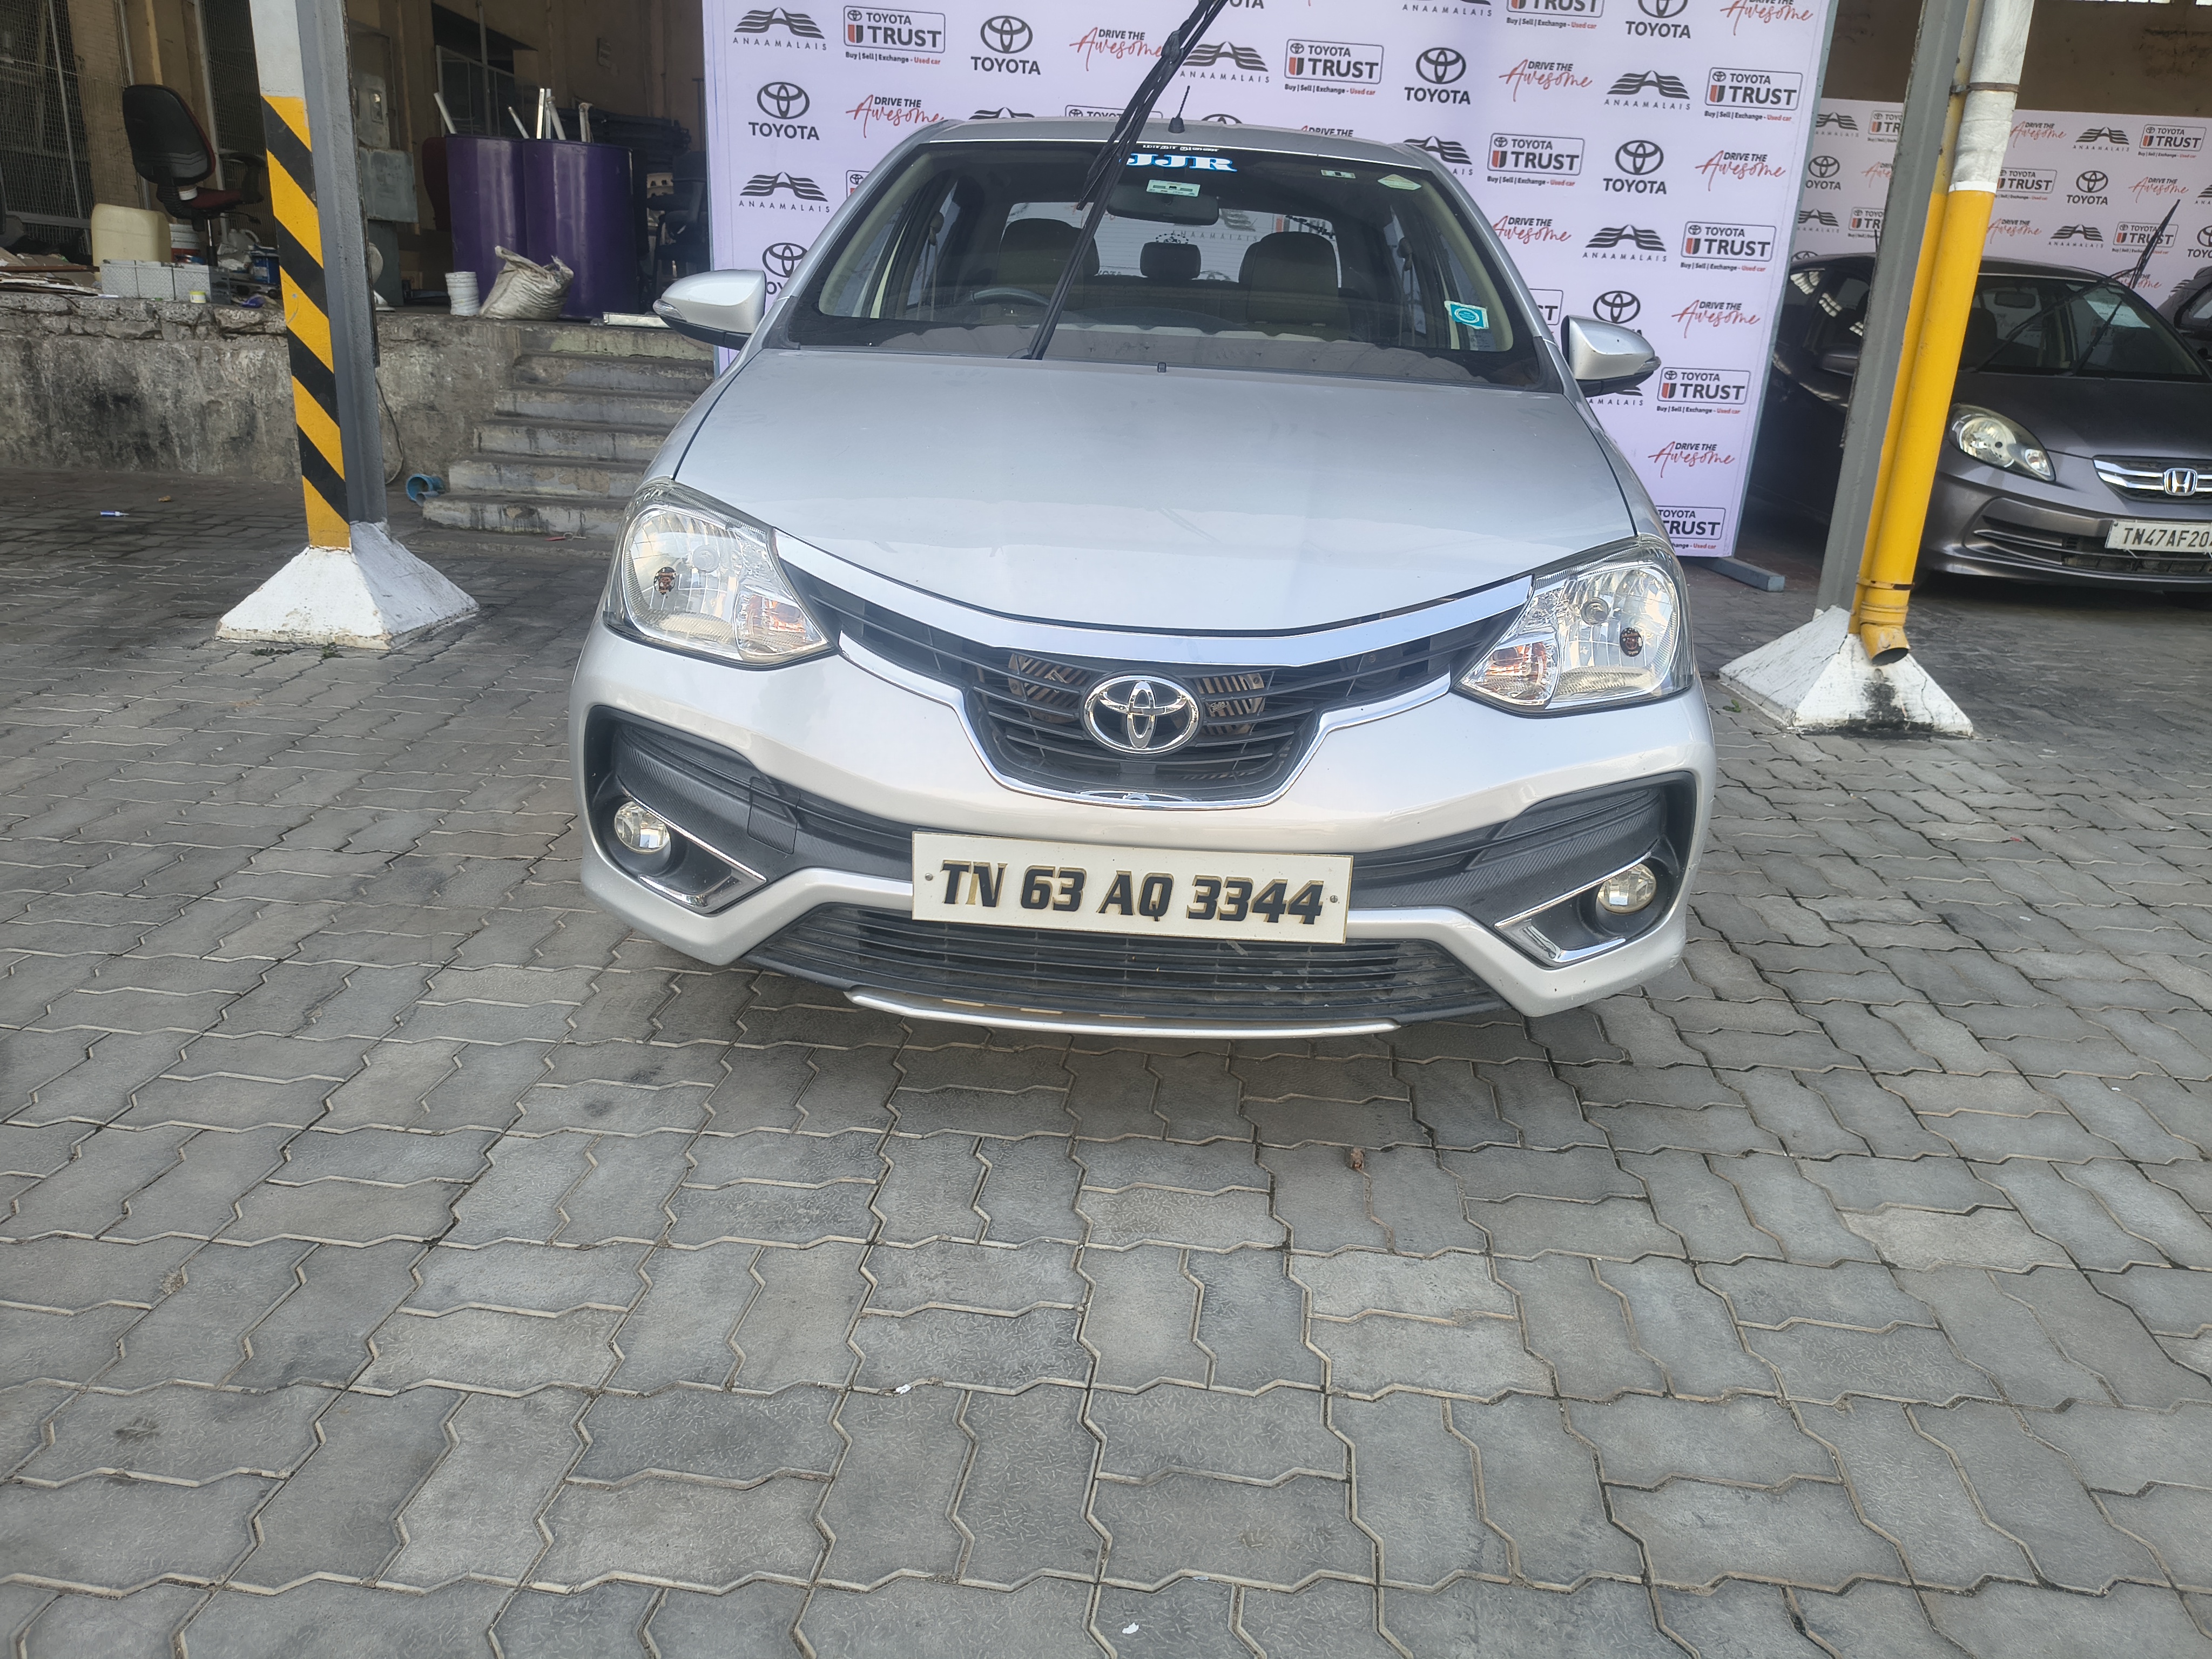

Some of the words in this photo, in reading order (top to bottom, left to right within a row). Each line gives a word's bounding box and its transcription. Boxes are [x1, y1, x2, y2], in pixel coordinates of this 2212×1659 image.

[1402, 4, 1492, 17] ANAAMALAIS
[866, 12, 912, 25] TOYOTA
[1507, 17, 1518, 25] Buy
[1538, 19, 1567, 28] Exchange
[1720, 0, 1813, 36] Awesome
[1098, 29, 1127, 40] DRIVE
[1128, 31, 1145, 41] THE
[1625, 21, 1691, 39] TOYOTA
[867, 26, 942, 48] TRUST
[732, 37, 827, 51] ANAAMALAIS
[1069, 27, 1163, 71] Awesome
[1308, 45, 1351, 57] TOYOTA
[845, 52, 858, 60] Buy
[879, 54, 909, 63] Exchange
[971, 56, 1041, 75] TOYOTA
[1308, 58, 1379, 79] TRUST
[1527, 61, 1555, 71] DRIVE
[1556, 63, 1573, 72] THE
[1179, 71, 1270, 83] ANAAMALAIS
[1499, 59, 1593, 102] Awesome
[1729, 73, 1771, 85] TOYOTA
[1284, 84, 1297, 92] Buy
[1316, 86, 1345, 95] Exchange
[1404, 87, 1471, 105] TOYOTA
[1729, 86, 1797, 106] TRUST
[874, 97, 902, 107] DRIVE
[904, 98, 922, 108] THE
[1604, 99, 1691, 111] ANAAMALAIS
[846, 94, 945, 138] Awesome
[1735, 112, 1763, 121] Exchange
[748, 122, 820, 140] TOYOTA
[1337, 129, 1354, 137] THE
[1511, 139, 1553, 150] TOYOTA
[2156, 136, 2202, 149] TRUST
[1510, 151, 1580, 171] TRUST
[1723, 152, 1750, 161] DRIVE
[1751, 154, 1768, 163] THE
[1695, 150, 1786, 192] Awesome
[1487, 176, 1499, 184] Buy
[1518, 178, 1546, 186] Exchange
[1603, 178, 1667, 195] TOYOTA
[1806, 180, 1841, 191] OYOTA
[2007, 179, 2052, 191] TRUST
[2066, 195, 2108, 205] TOYOTA
[739, 200, 831, 213] ANAAMALAIS
[1508, 217, 1534, 226] DRIVE
[1535, 218, 1553, 227] THE
[1705, 227, 1745, 238] TOYOTA
[1704, 238, 1770, 257] TRUST
[1582, 252, 1667, 262] ANAAMALAIS
[1699, 301, 1725, 310] DRIVE
[1725, 302, 1742, 311] THE
[1671, 300, 1761, 339] Awesome
[1681, 372, 1721, 382] TOYOTA
[1680, 383, 1745, 400] TRUST
[1648, 441, 1735, 478] Awesome
[1658, 509, 1696, 518] TOYOTA
[940, 859, 1008, 908] TN
[1020, 865, 1087, 912] 63
[1096, 869, 1175, 921] AQ
[1186, 874, 1325, 925] 3344
